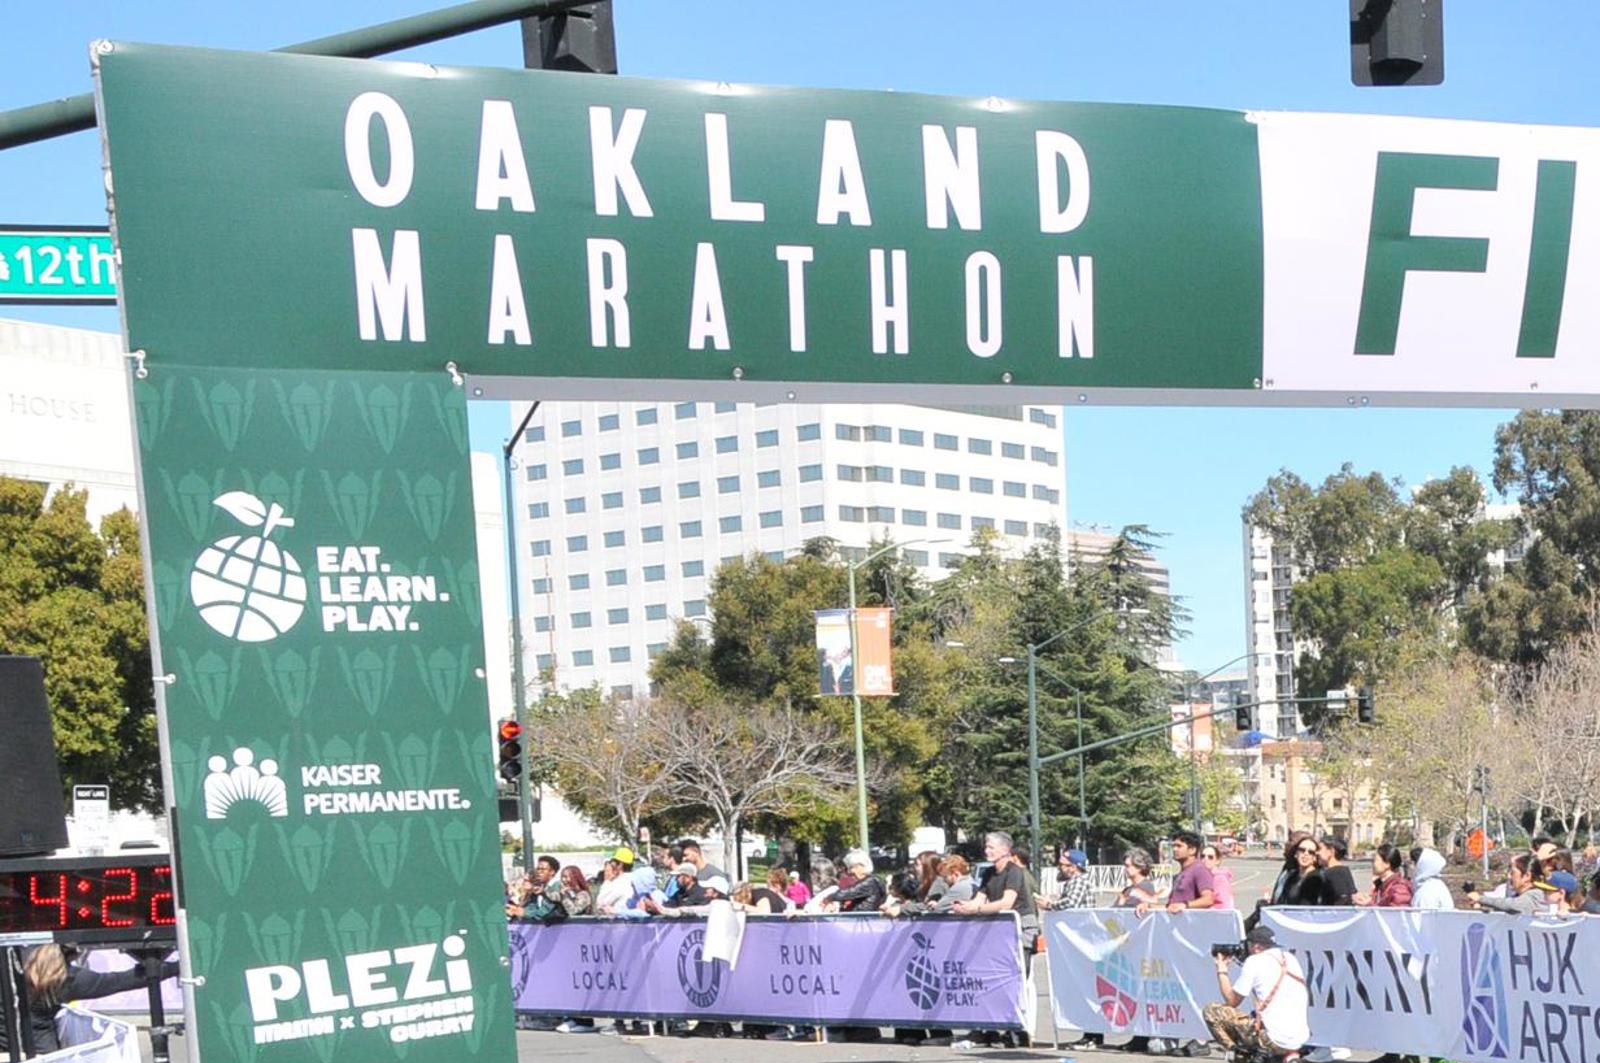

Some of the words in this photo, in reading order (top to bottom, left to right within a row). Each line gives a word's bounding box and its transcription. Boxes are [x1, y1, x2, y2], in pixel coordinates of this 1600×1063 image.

[344, 91, 1092, 234] OAKLAND
[14, 244, 117, 285] 12th
[352, 228, 1095, 359] MARATHON
[316, 546, 391, 573] EAT.
[319, 576, 450, 601] LEARN.
[321, 605, 420, 631] PLAY.
[301, 764, 382, 787] KAISER
[581, 944, 615, 964] RUN
[780, 944, 823, 966] RUN
[1508, 929, 1584, 997] HJK
[943, 960, 968, 975] EAT.
[572, 971, 628, 991] LOCAL
[769, 973, 840, 996] LOCAL
[944, 977, 989, 991] LEARN.
[946, 993, 979, 1006] PLAY.
[1146, 1004, 1185, 1024] PLAY.
